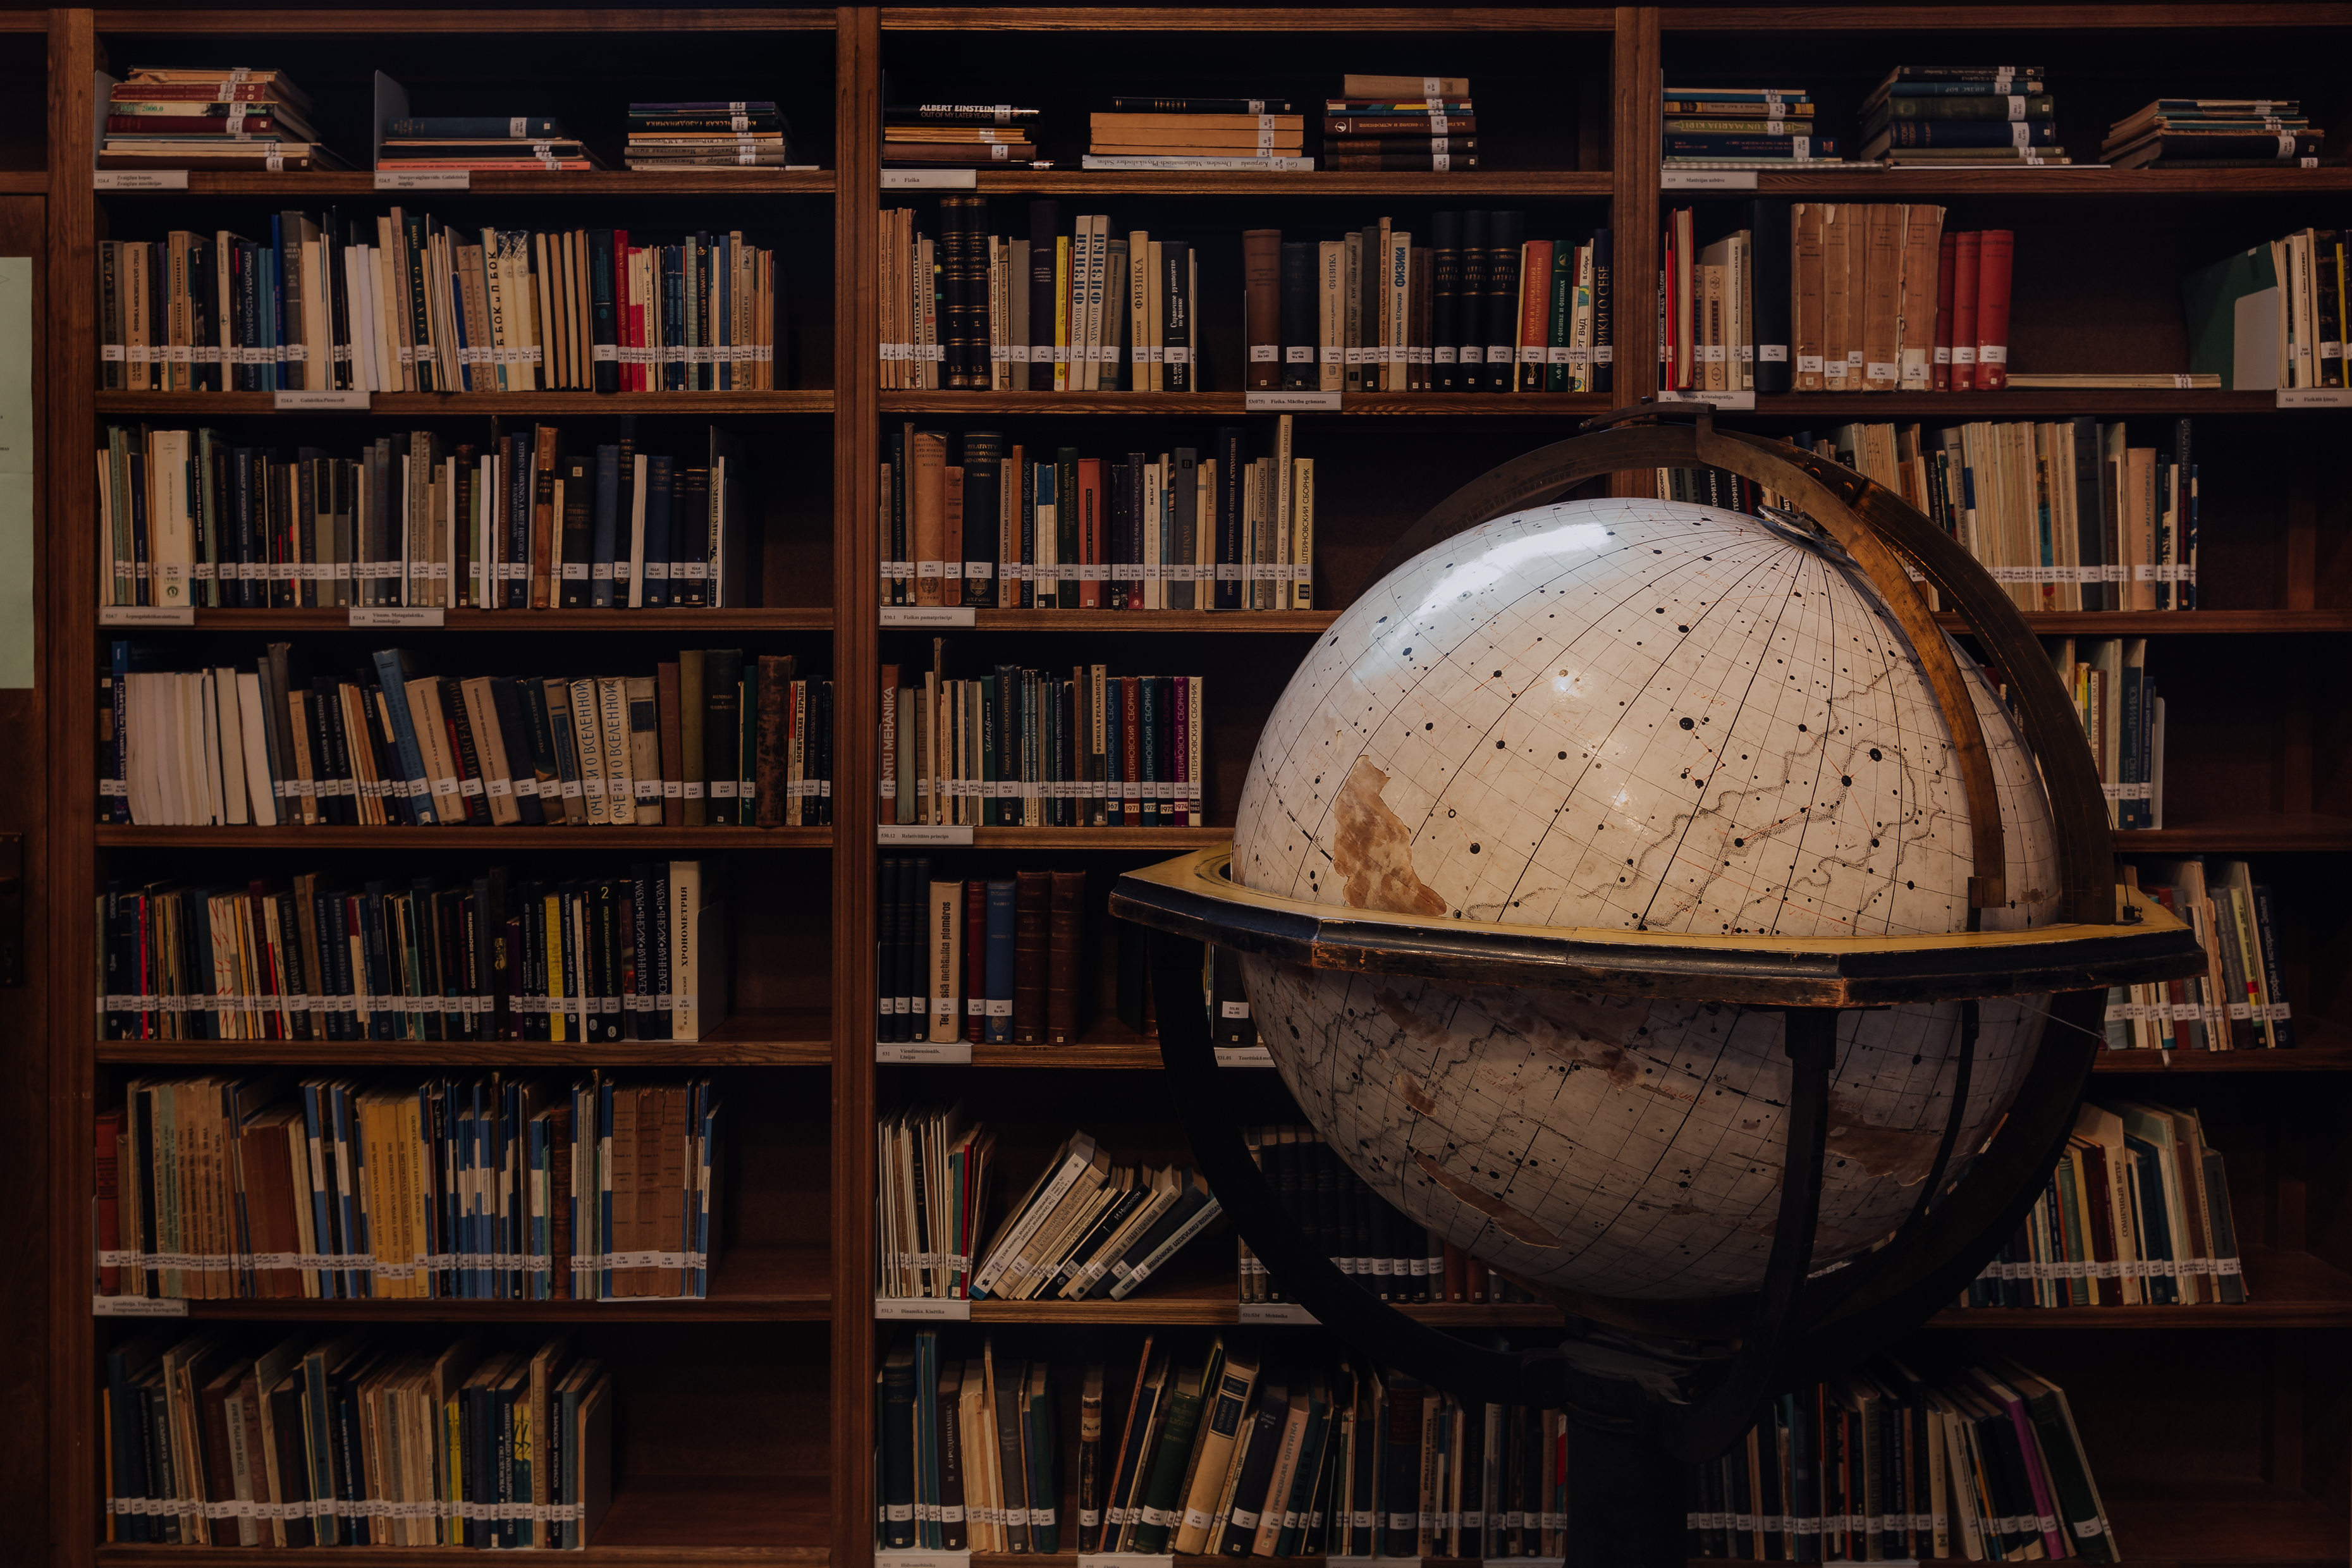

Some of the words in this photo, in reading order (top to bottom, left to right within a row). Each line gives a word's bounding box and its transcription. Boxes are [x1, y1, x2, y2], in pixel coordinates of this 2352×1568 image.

[1116, 159, 1202, 168] Mathematisch-Physikalischer
[244, 252, 254, 294] АНДРОМЕДЫ
[1074, 233, 1087, 305] ФИЗИКИ
[1091, 233, 1105, 305] ФИЗИКИ
[1394, 247, 1406, 287] ФИЗИКА
[1598, 266, 1610, 295] СЕБЕ
[246, 296, 254, 344] ТУМАННОСТЬ
[413, 266, 426, 338] GALAXIES
[1598, 299, 1608, 309] О
[1074, 308, 1082, 341] ХРАМОВ
[254, 460, 262, 499] ГАЛАКТИКИ
[1929, 462, 1939, 505] магнитосферы
[255, 502, 264, 536] ДВОЙНЫЕ
[363, 689, 373, 718] Квазары
[574, 683, 596, 754] ВСЕЛЕННОЙ
[603, 685, 622, 756] ВСЕЛЕННОЙ
[883, 686, 894, 749] MEHĀNIKA
[2092, 704, 2098, 715] НА
[317, 899, 327, 941] КОСМОГОНИИ
[334, 898, 343, 941] КОСМОГОНИИ
[941, 902, 952, 940] piemēros
[2259, 896, 2269, 923] Земли
[941, 942, 950, 981] mehānika
[2263, 927, 2274, 960] история
[322, 944, 332, 993] СОВРЕМЕННОЙ
[338, 943, 348, 993] СОВРЕМЕННОЙ
[2114, 1160, 2124, 1184] ВЕТЕР
[2117, 1187, 2128, 1237] СОЛНЕЧНЫЙ
[231, 1402, 240, 1423] ЗЕМЛИ
[233, 1425, 243, 1450] ФИГУРЫ
[946, 1404, 955, 1469] АЭРОДИНАМИКА
[1284, 1422, 1298, 1461] ОПТИКА
[236, 1452, 244, 1476] ТЕОРИЯ
